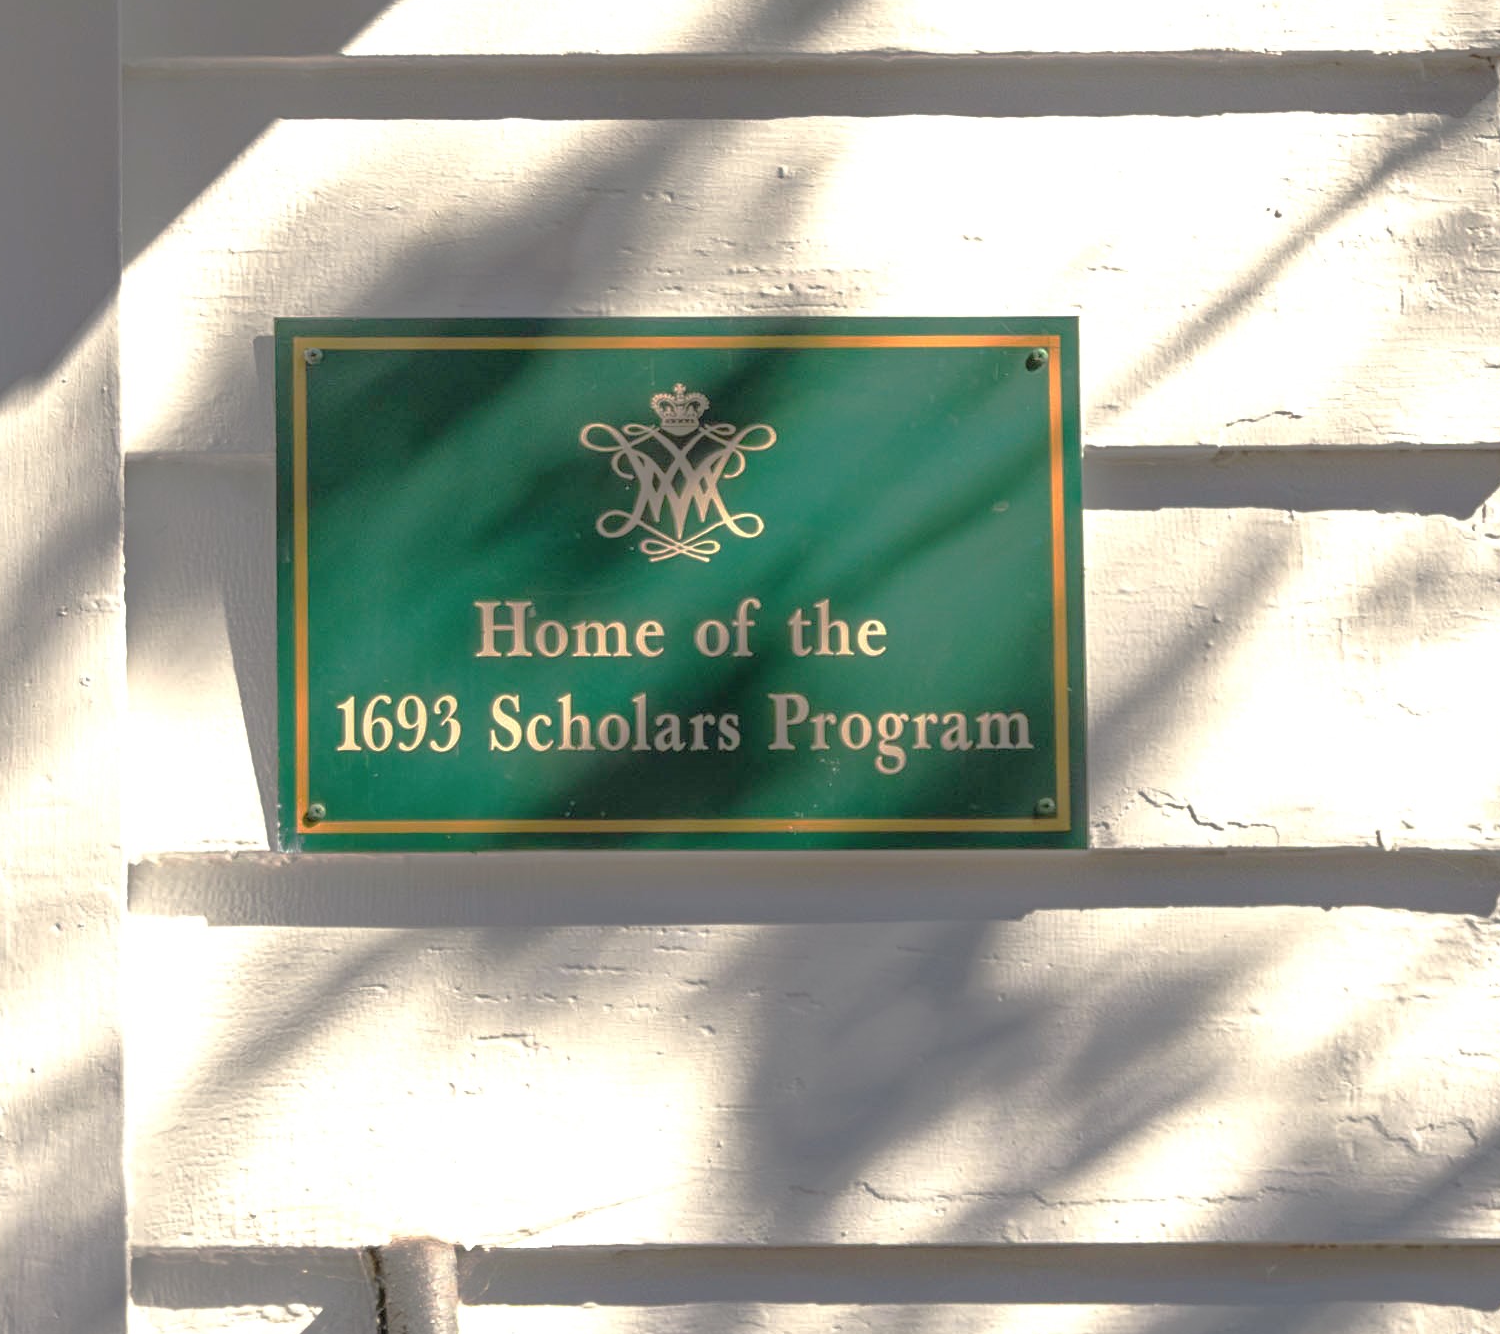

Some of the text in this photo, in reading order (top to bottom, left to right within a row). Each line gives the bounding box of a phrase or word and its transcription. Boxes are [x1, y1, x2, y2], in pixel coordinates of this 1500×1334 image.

[474, 597, 888, 658] Home of the
[336, 692, 1033, 775] 1693 Scholars Program
